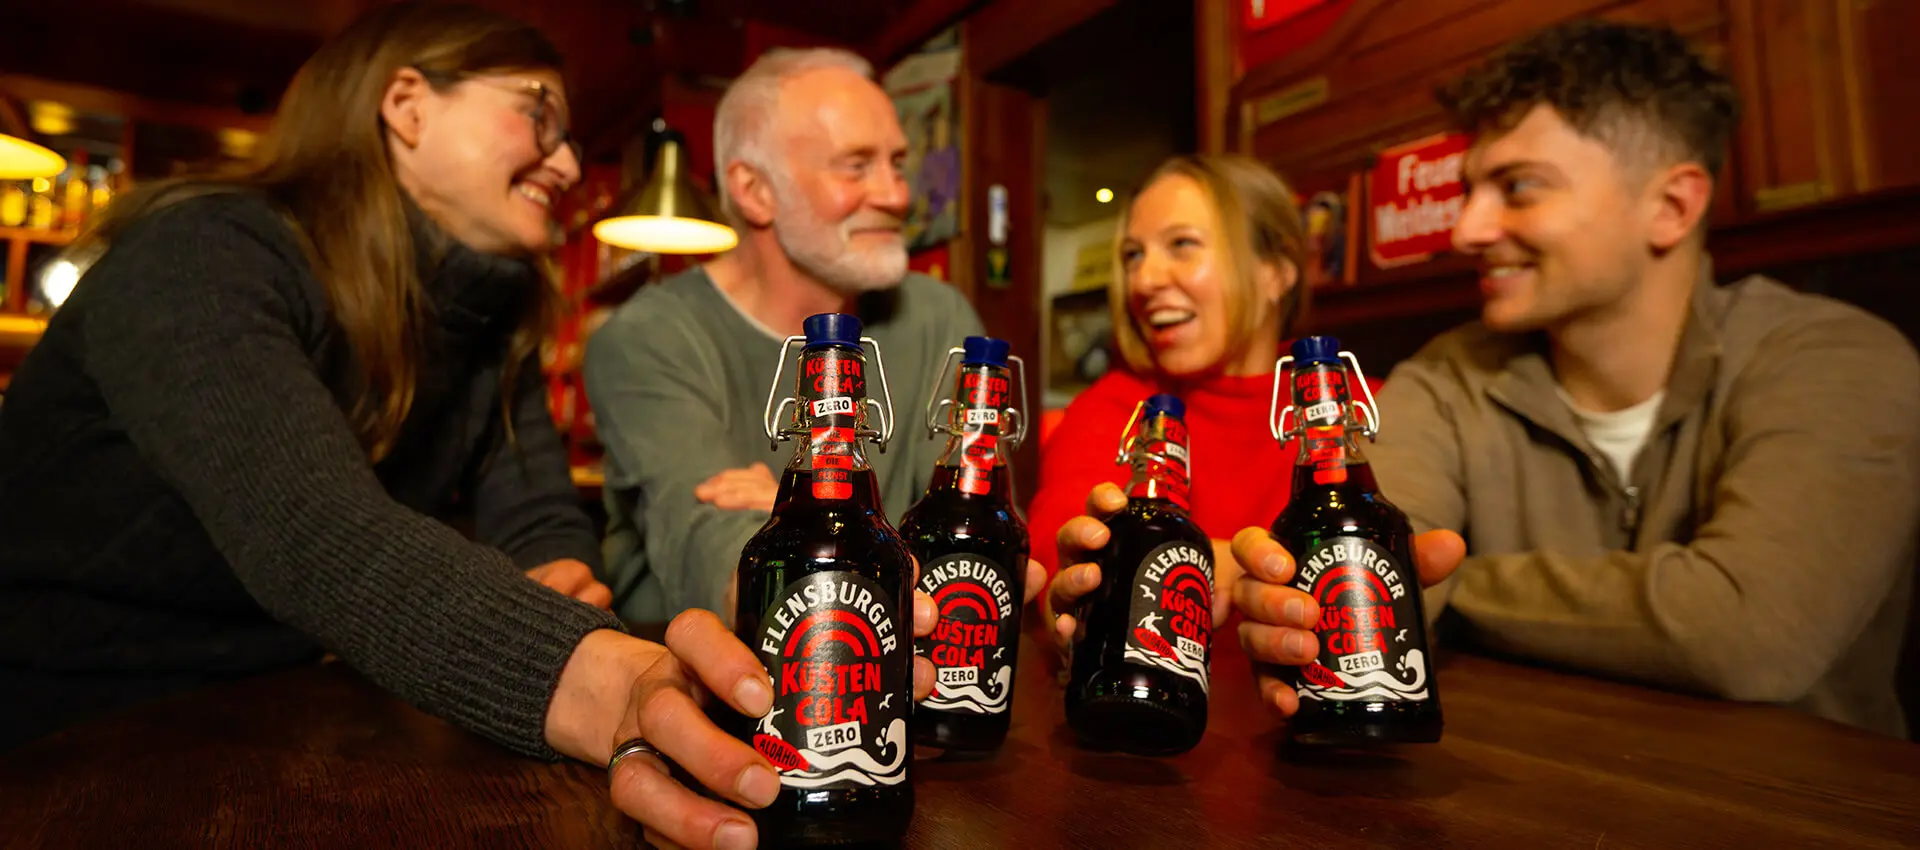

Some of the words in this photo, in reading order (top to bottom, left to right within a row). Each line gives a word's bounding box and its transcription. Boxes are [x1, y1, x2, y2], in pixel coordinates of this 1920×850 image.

[963, 372, 1008, 394] KÜTEN
[1295, 371, 1342, 392] KÜSEN
[968, 389, 1000, 408] CLA
[1303, 386, 1338, 402] COA
[818, 400, 850, 413] ZERO
[1310, 405, 1336, 417] ZERO
[1297, 544, 1405, 600] LENSBURGER
[761, 581, 897, 656] FLENSBURGER
[1161, 588, 1211, 632] KÜSTE
[1314, 605, 1396, 633] KÜSTEN
[930, 618, 998, 647] ÜSTEN
[1170, 614, 1207, 652] COLA
[1327, 631, 1388, 655] COLA
[931, 644, 985, 670] COLA
[1181, 640, 1203, 658] ZERO
[1344, 655, 1379, 670] ZERO
[781, 662, 881, 697] KÜSTEN
[943, 671, 975, 682] ZERO
[795, 695, 868, 726] COLA
[813, 727, 856, 748] ZERO
